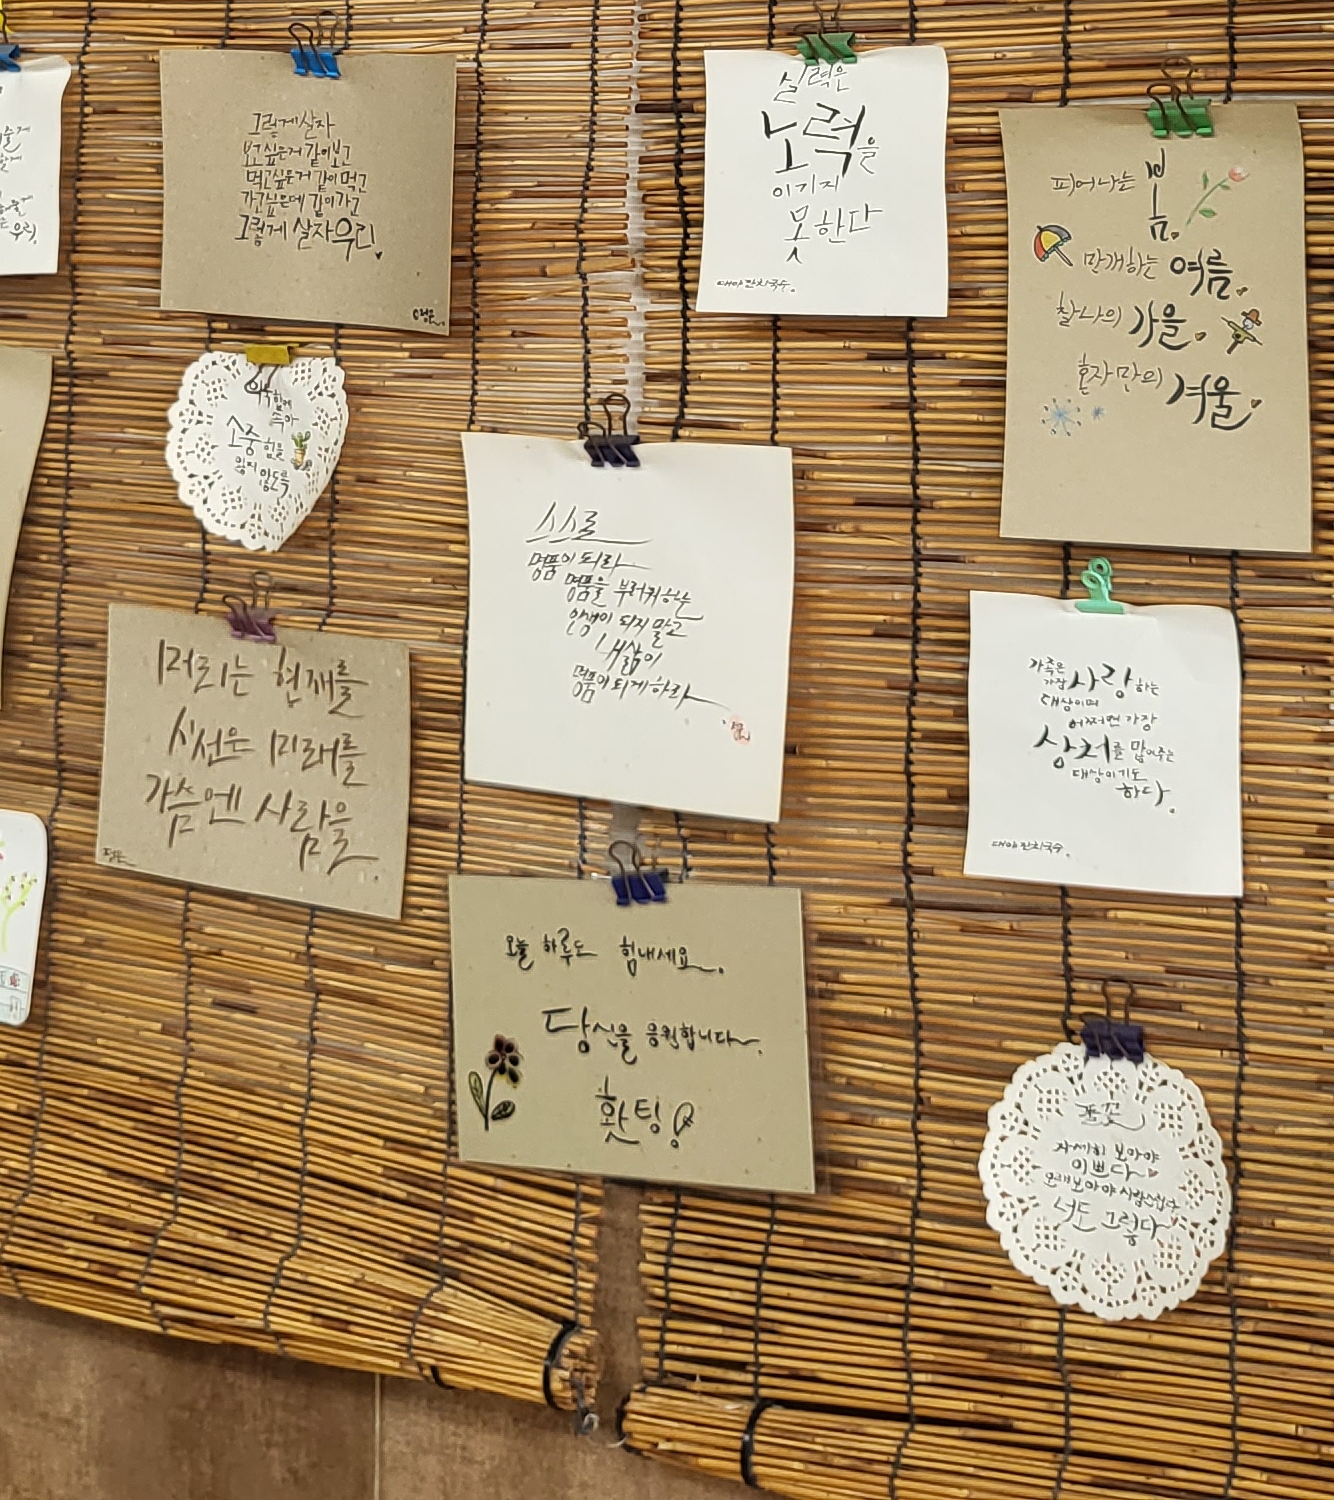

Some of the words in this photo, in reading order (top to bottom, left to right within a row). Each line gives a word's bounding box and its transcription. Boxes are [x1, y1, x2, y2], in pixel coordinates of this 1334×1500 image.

[772, 63, 851, 106] 실력은
[760, 101, 881, 179] 노력을
[771, 172, 841, 198] 이기지
[1049, 170, 1137, 197] 피어나는
[783, 202, 885, 266] 못한다
[1083, 245, 1160, 280] 만개하는
[1168, 247, 1235, 300] 여름
[1127, 299, 1194, 352] 가을
[524, 500, 653, 545] 스스로
[157, 637, 257, 699] 머리는
[272, 645, 371, 720] 현재를
[168, 705, 257, 769] 시선은
[270, 728, 371, 789] 미래를
[145, 773, 247, 850] 가슴엔
[504, 934, 535, 973] 오늘
[540, 1005, 639, 1066] 당신을
